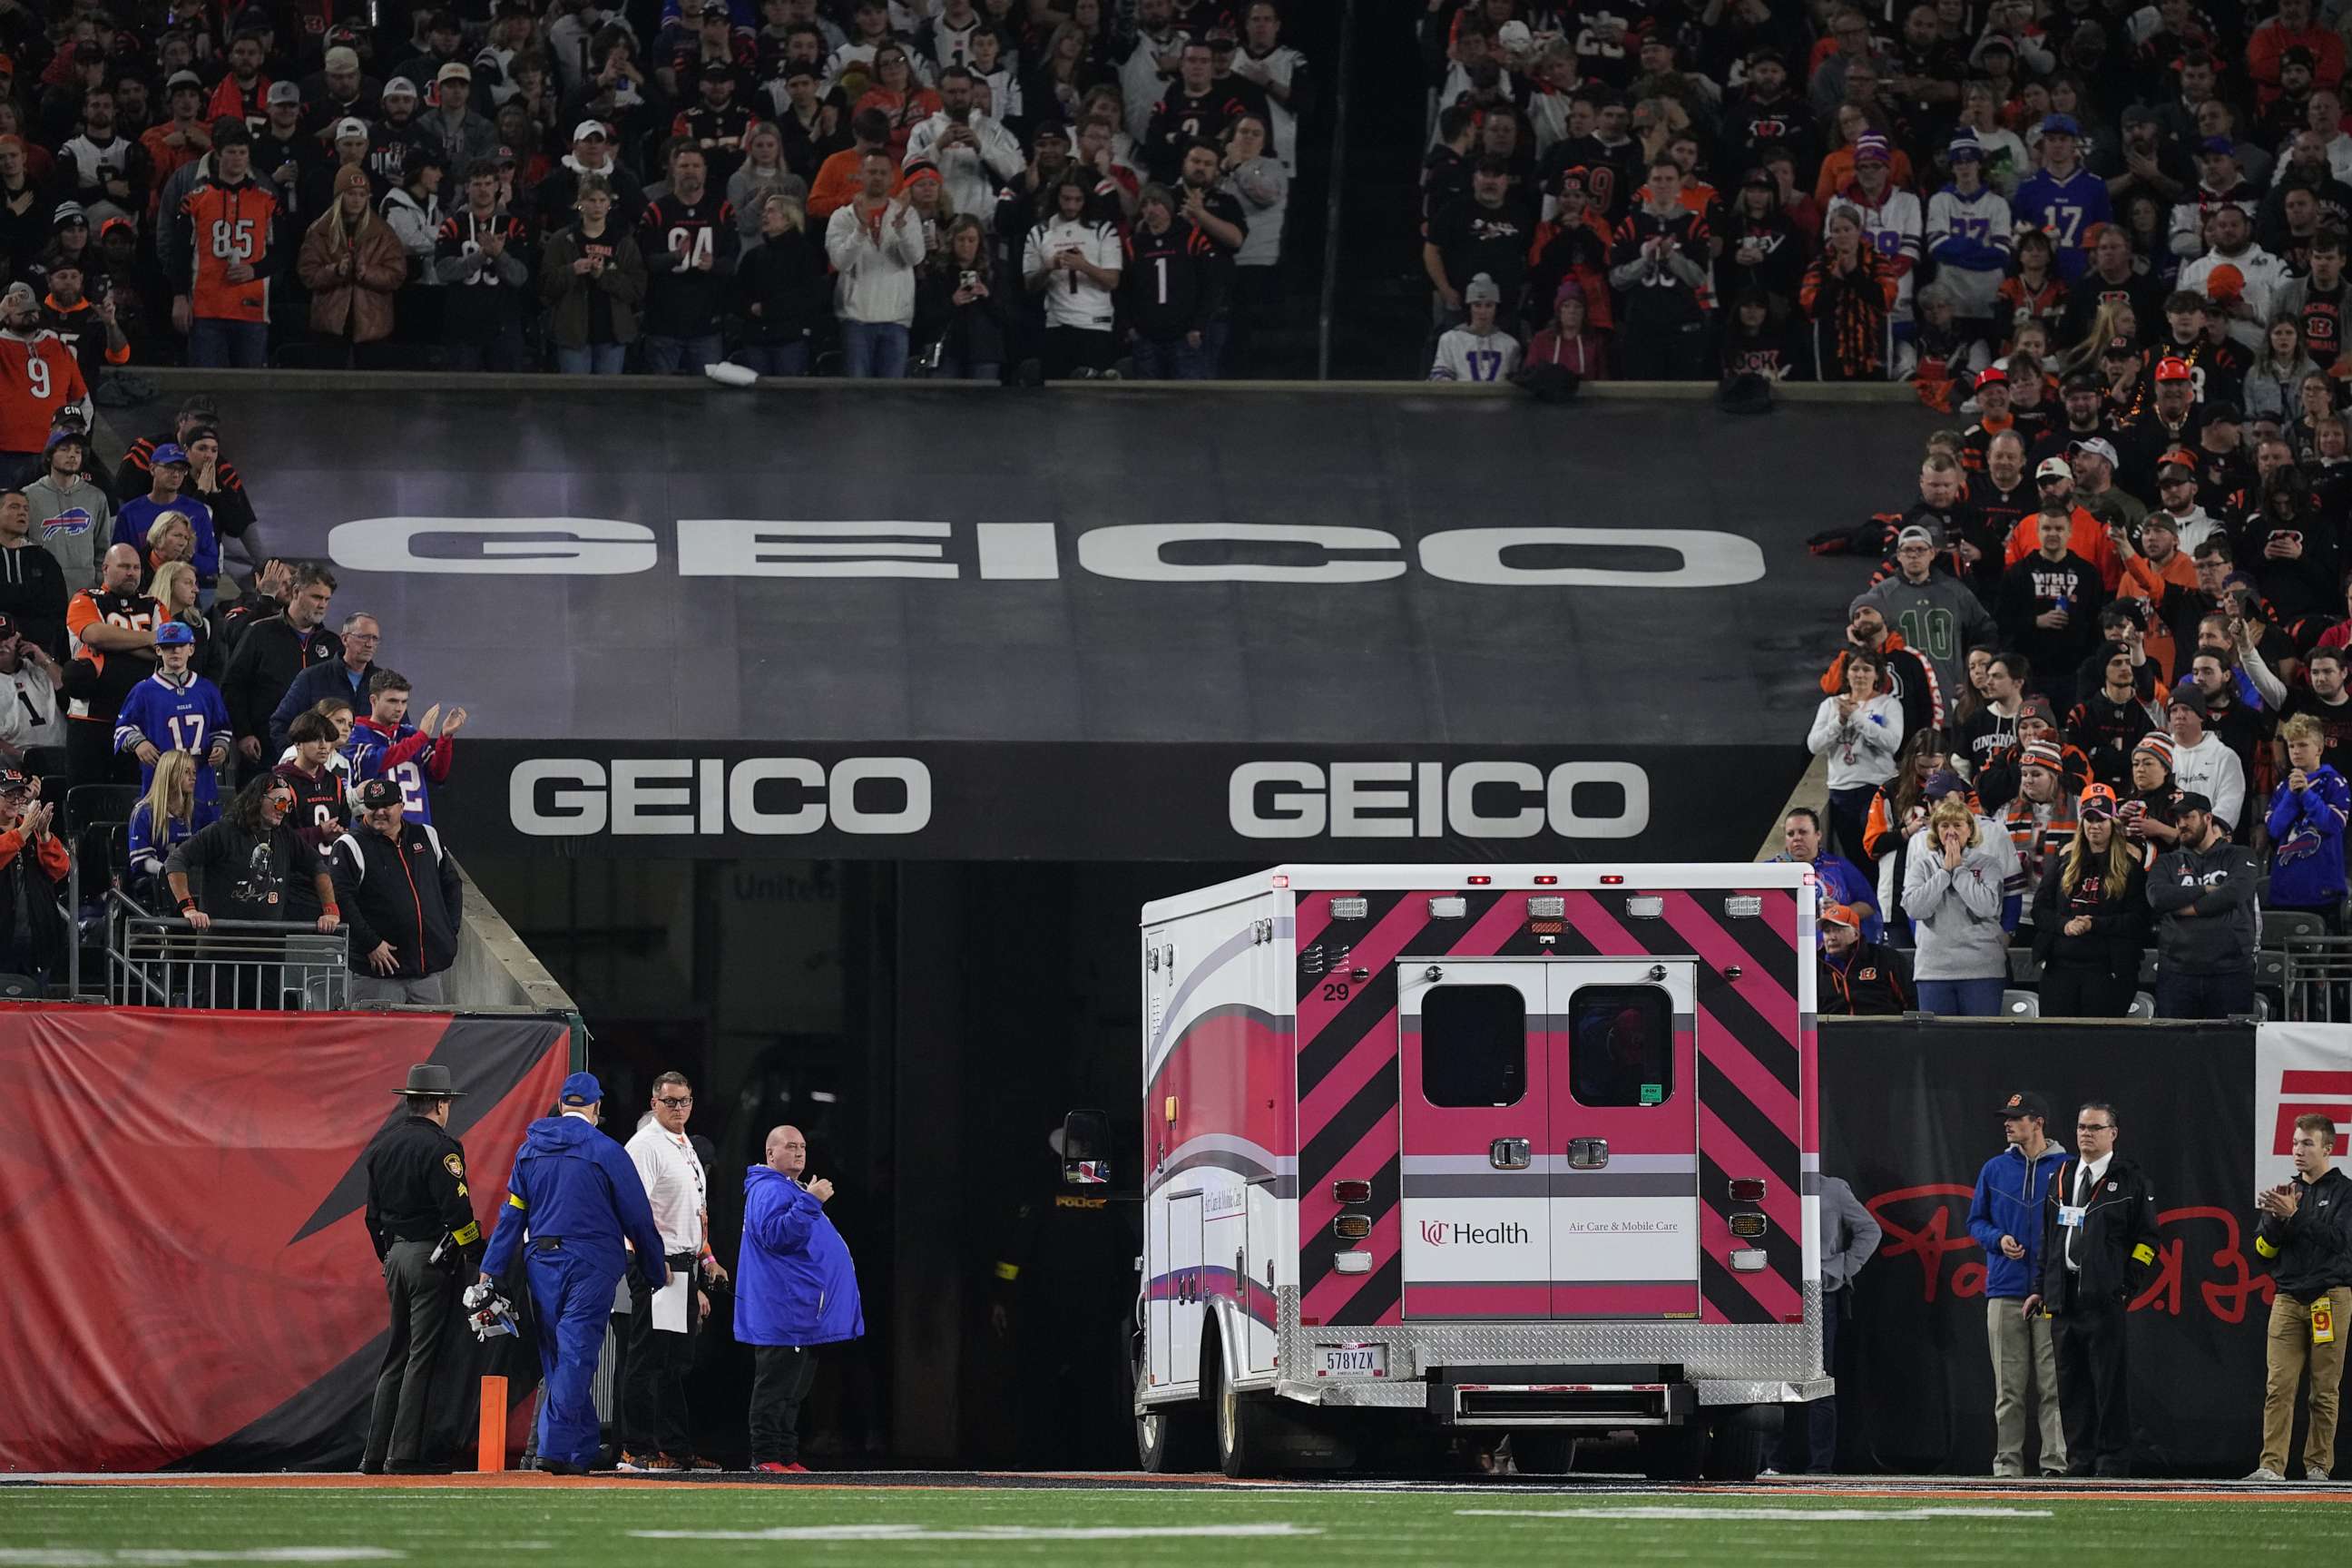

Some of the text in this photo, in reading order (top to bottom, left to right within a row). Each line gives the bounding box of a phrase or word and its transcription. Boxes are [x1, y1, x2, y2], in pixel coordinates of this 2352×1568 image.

[212, 219, 254, 259] 85
[2043, 206, 2083, 247] 17
[1154, 257, 1168, 304] 1
[26, 358, 51, 399] 9
[1466, 351, 1502, 381] 17
[328, 517, 1765, 587] GEICO
[2031, 572, 2079, 585] WHO
[1899, 607, 1954, 661] 10
[18, 691, 46, 727] 1
[167, 713, 206, 756] 17
[510, 759, 932, 836] GEICO
[1229, 761, 1650, 838] GEICO
[1323, 983, 1349, 1002] 29
[1419, 1220, 1528, 1247] UC Health
[1569, 1220, 1679, 1232] Air Care & Mobile Care
[2314, 1311, 2330, 1331] 9
[1327, 1352, 1374, 1370] 578YZX
